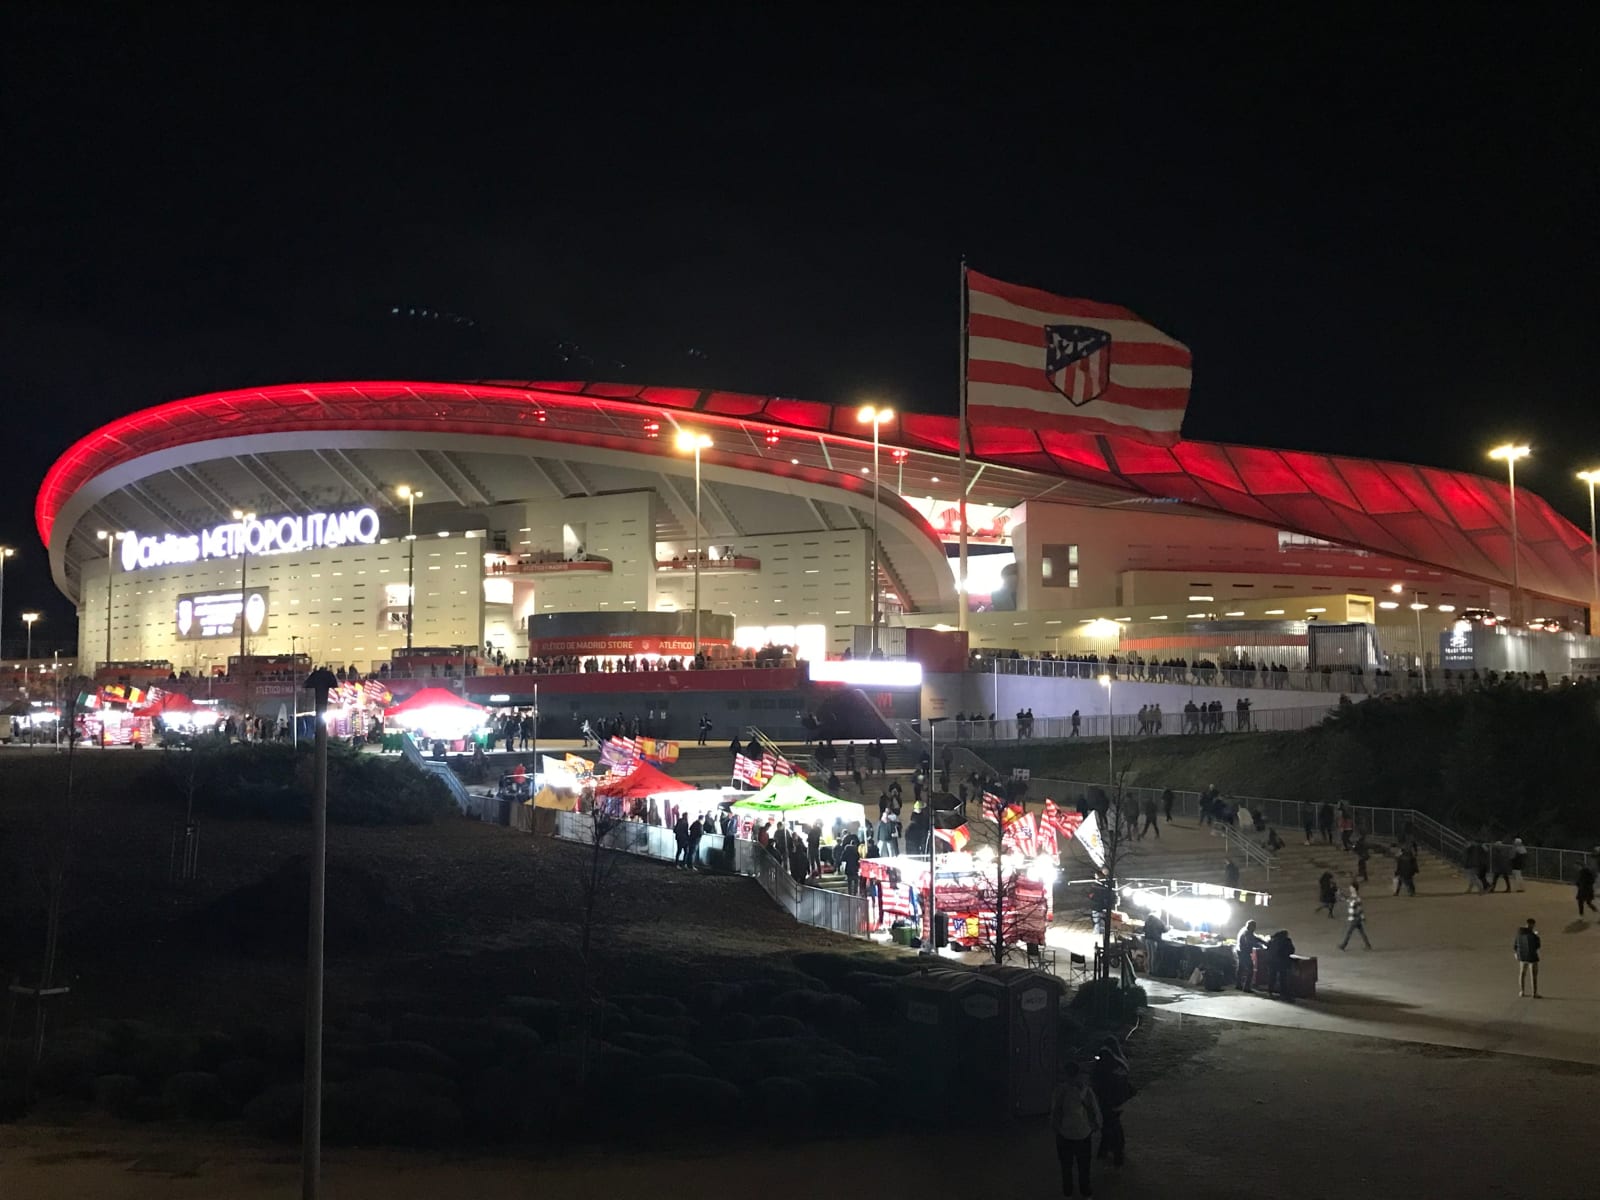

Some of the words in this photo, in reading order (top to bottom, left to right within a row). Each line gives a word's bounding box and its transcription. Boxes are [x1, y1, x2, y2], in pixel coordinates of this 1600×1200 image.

[202, 508, 379, 558] METROPOLITANO
[576, 640, 607, 649] MADRID
[607, 640, 633, 649] STORE
[659, 639, 692, 650] ATLÉTICO
